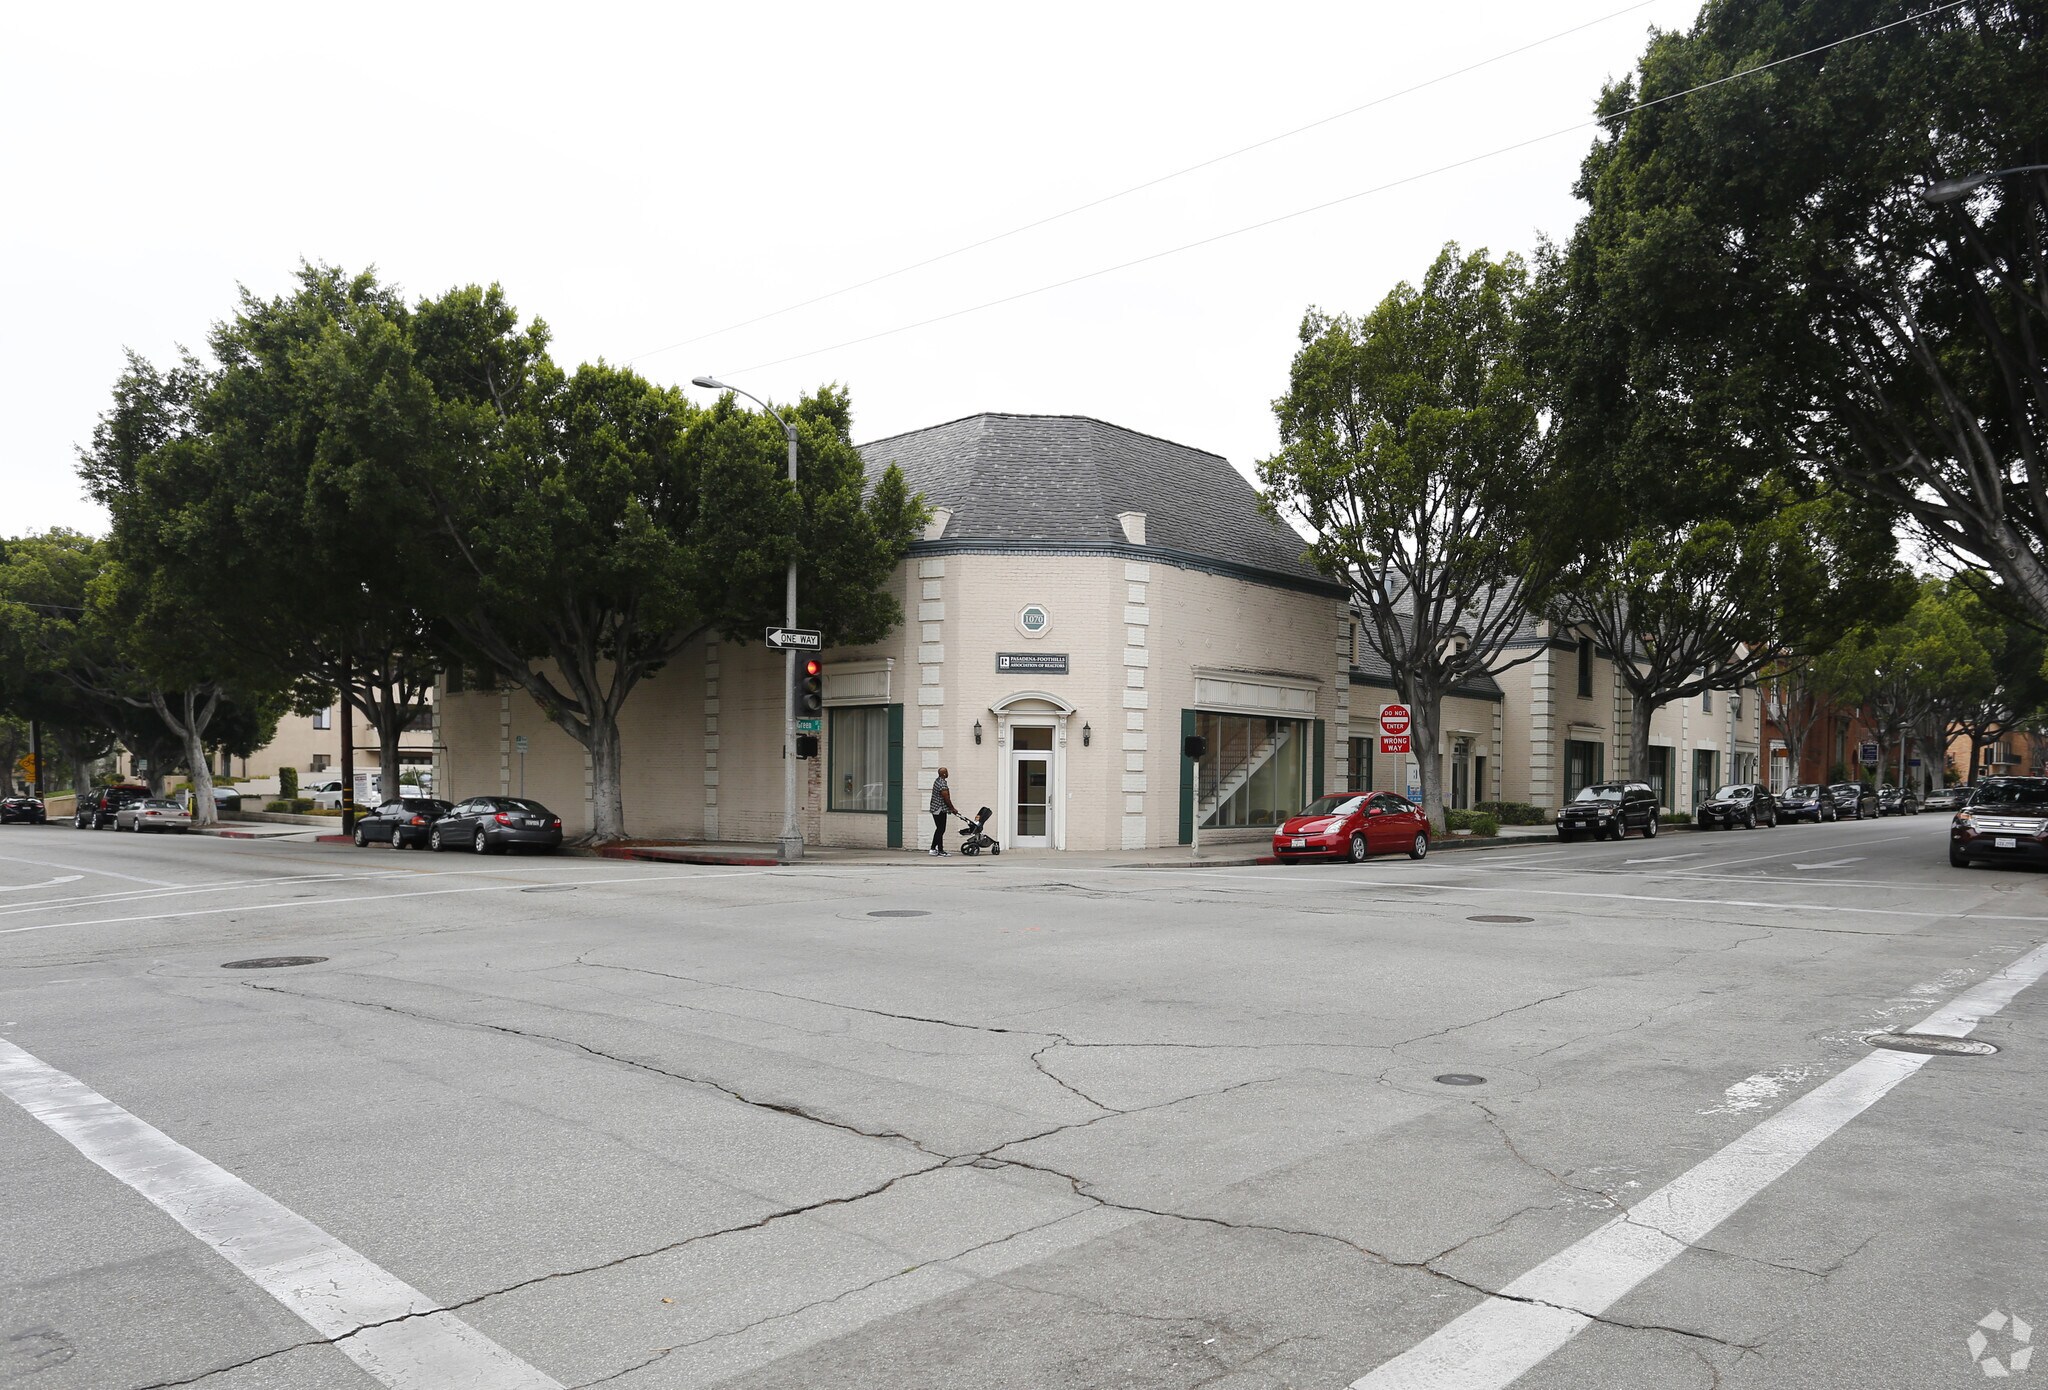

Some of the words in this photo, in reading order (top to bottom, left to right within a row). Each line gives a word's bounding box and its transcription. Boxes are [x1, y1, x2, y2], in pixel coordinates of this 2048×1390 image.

[1025, 615, 1043, 623] 1070
[781, 633, 796, 643] ONE
[800, 635, 816, 644] WAY
[797, 720, 812, 729] Green
